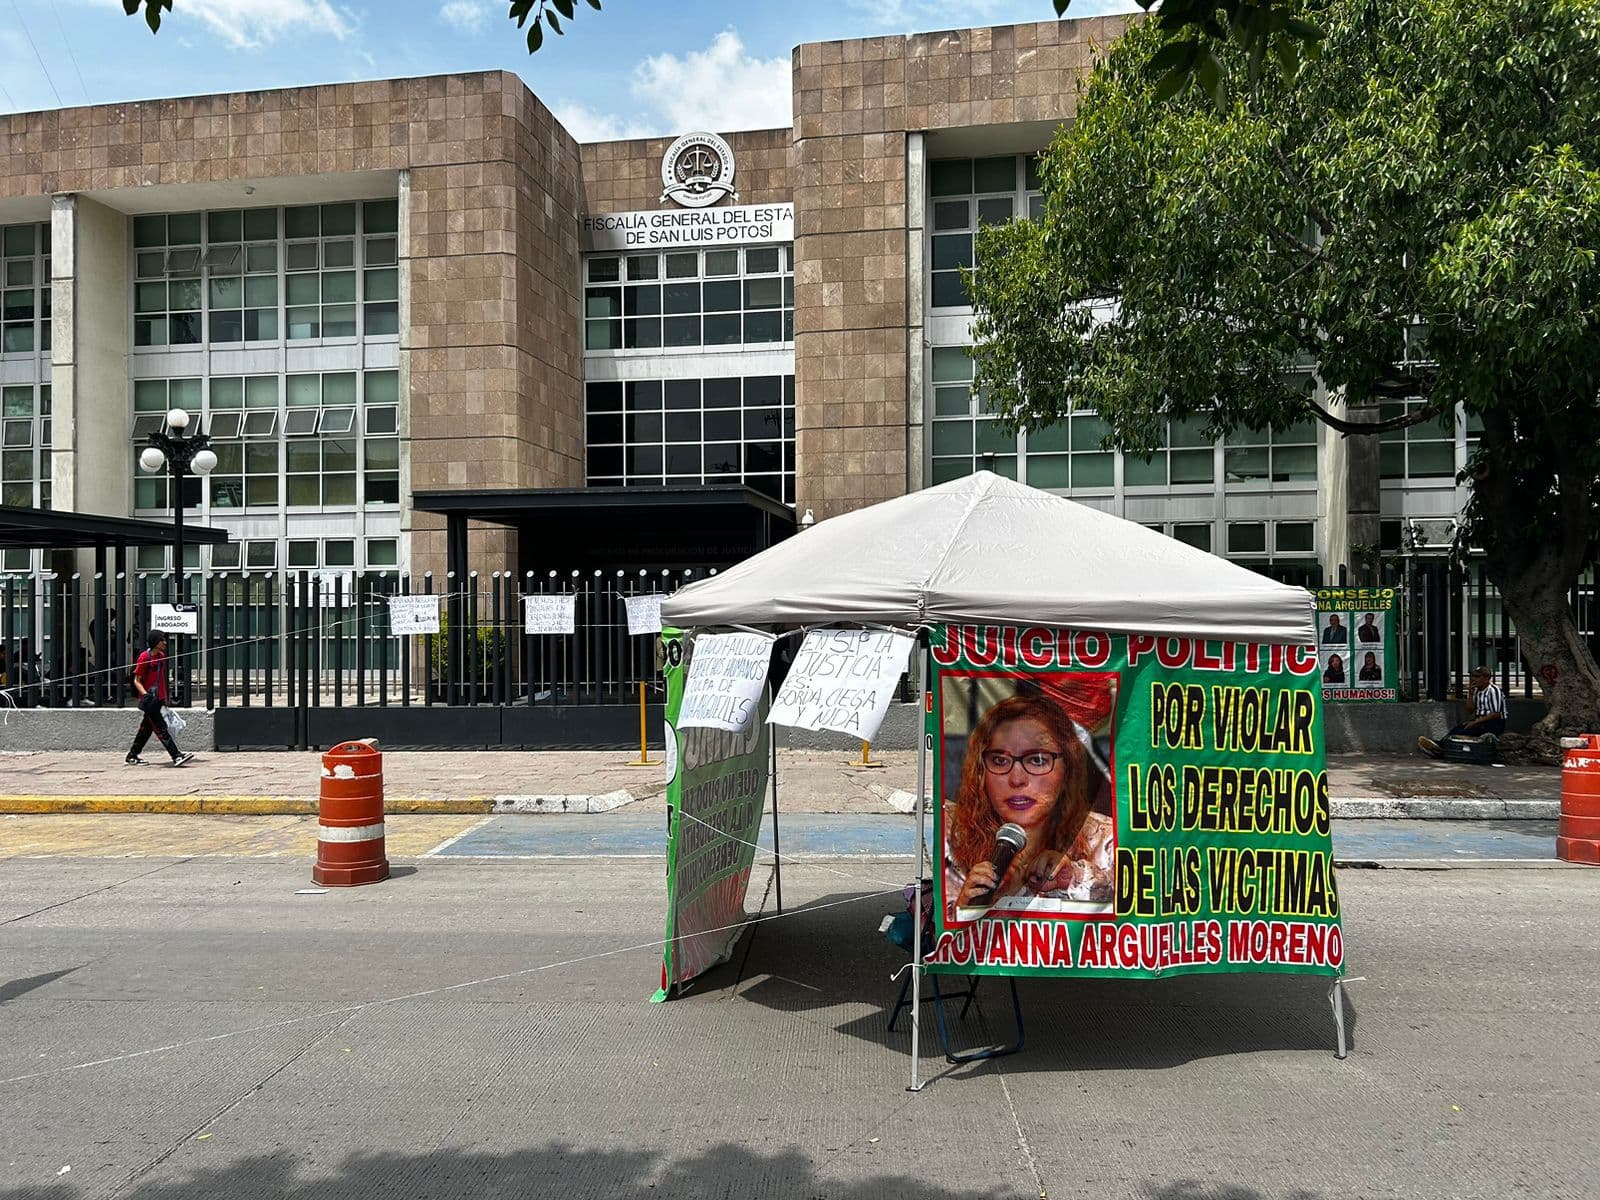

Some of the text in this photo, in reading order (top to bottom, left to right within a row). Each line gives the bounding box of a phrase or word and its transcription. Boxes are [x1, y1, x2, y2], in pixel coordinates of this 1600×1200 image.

[680, 136, 706, 148] GENERAL
[584, 213, 647, 231] FISCALÍA
[651, 211, 720, 227] GENERAL
[723, 210, 751, 224] DEL
[626, 221, 773, 244] DE SAN LUIS POTOSÍ
[1334, 599, 1392, 610] ARGUELLES
[801, 630, 895, 656] EN SLP LA
[931, 624, 1112, 668] JUICIO
[718, 679, 737, 693] DE
[1333, 688, 1395, 700] HUMANOS!!
[825, 687, 877, 711] CIEGA
[793, 705, 806, 726] Y
[1152, 682, 1314, 754] POR VIOLAR
[1128, 763, 1331, 837] LOS DERECHOS
[1115, 847, 1156, 916] DE
[1160, 846, 1202, 916] LAS
[1077, 922, 1222, 970] ARGUELLES
[1228, 920, 1344, 969] MORENO
